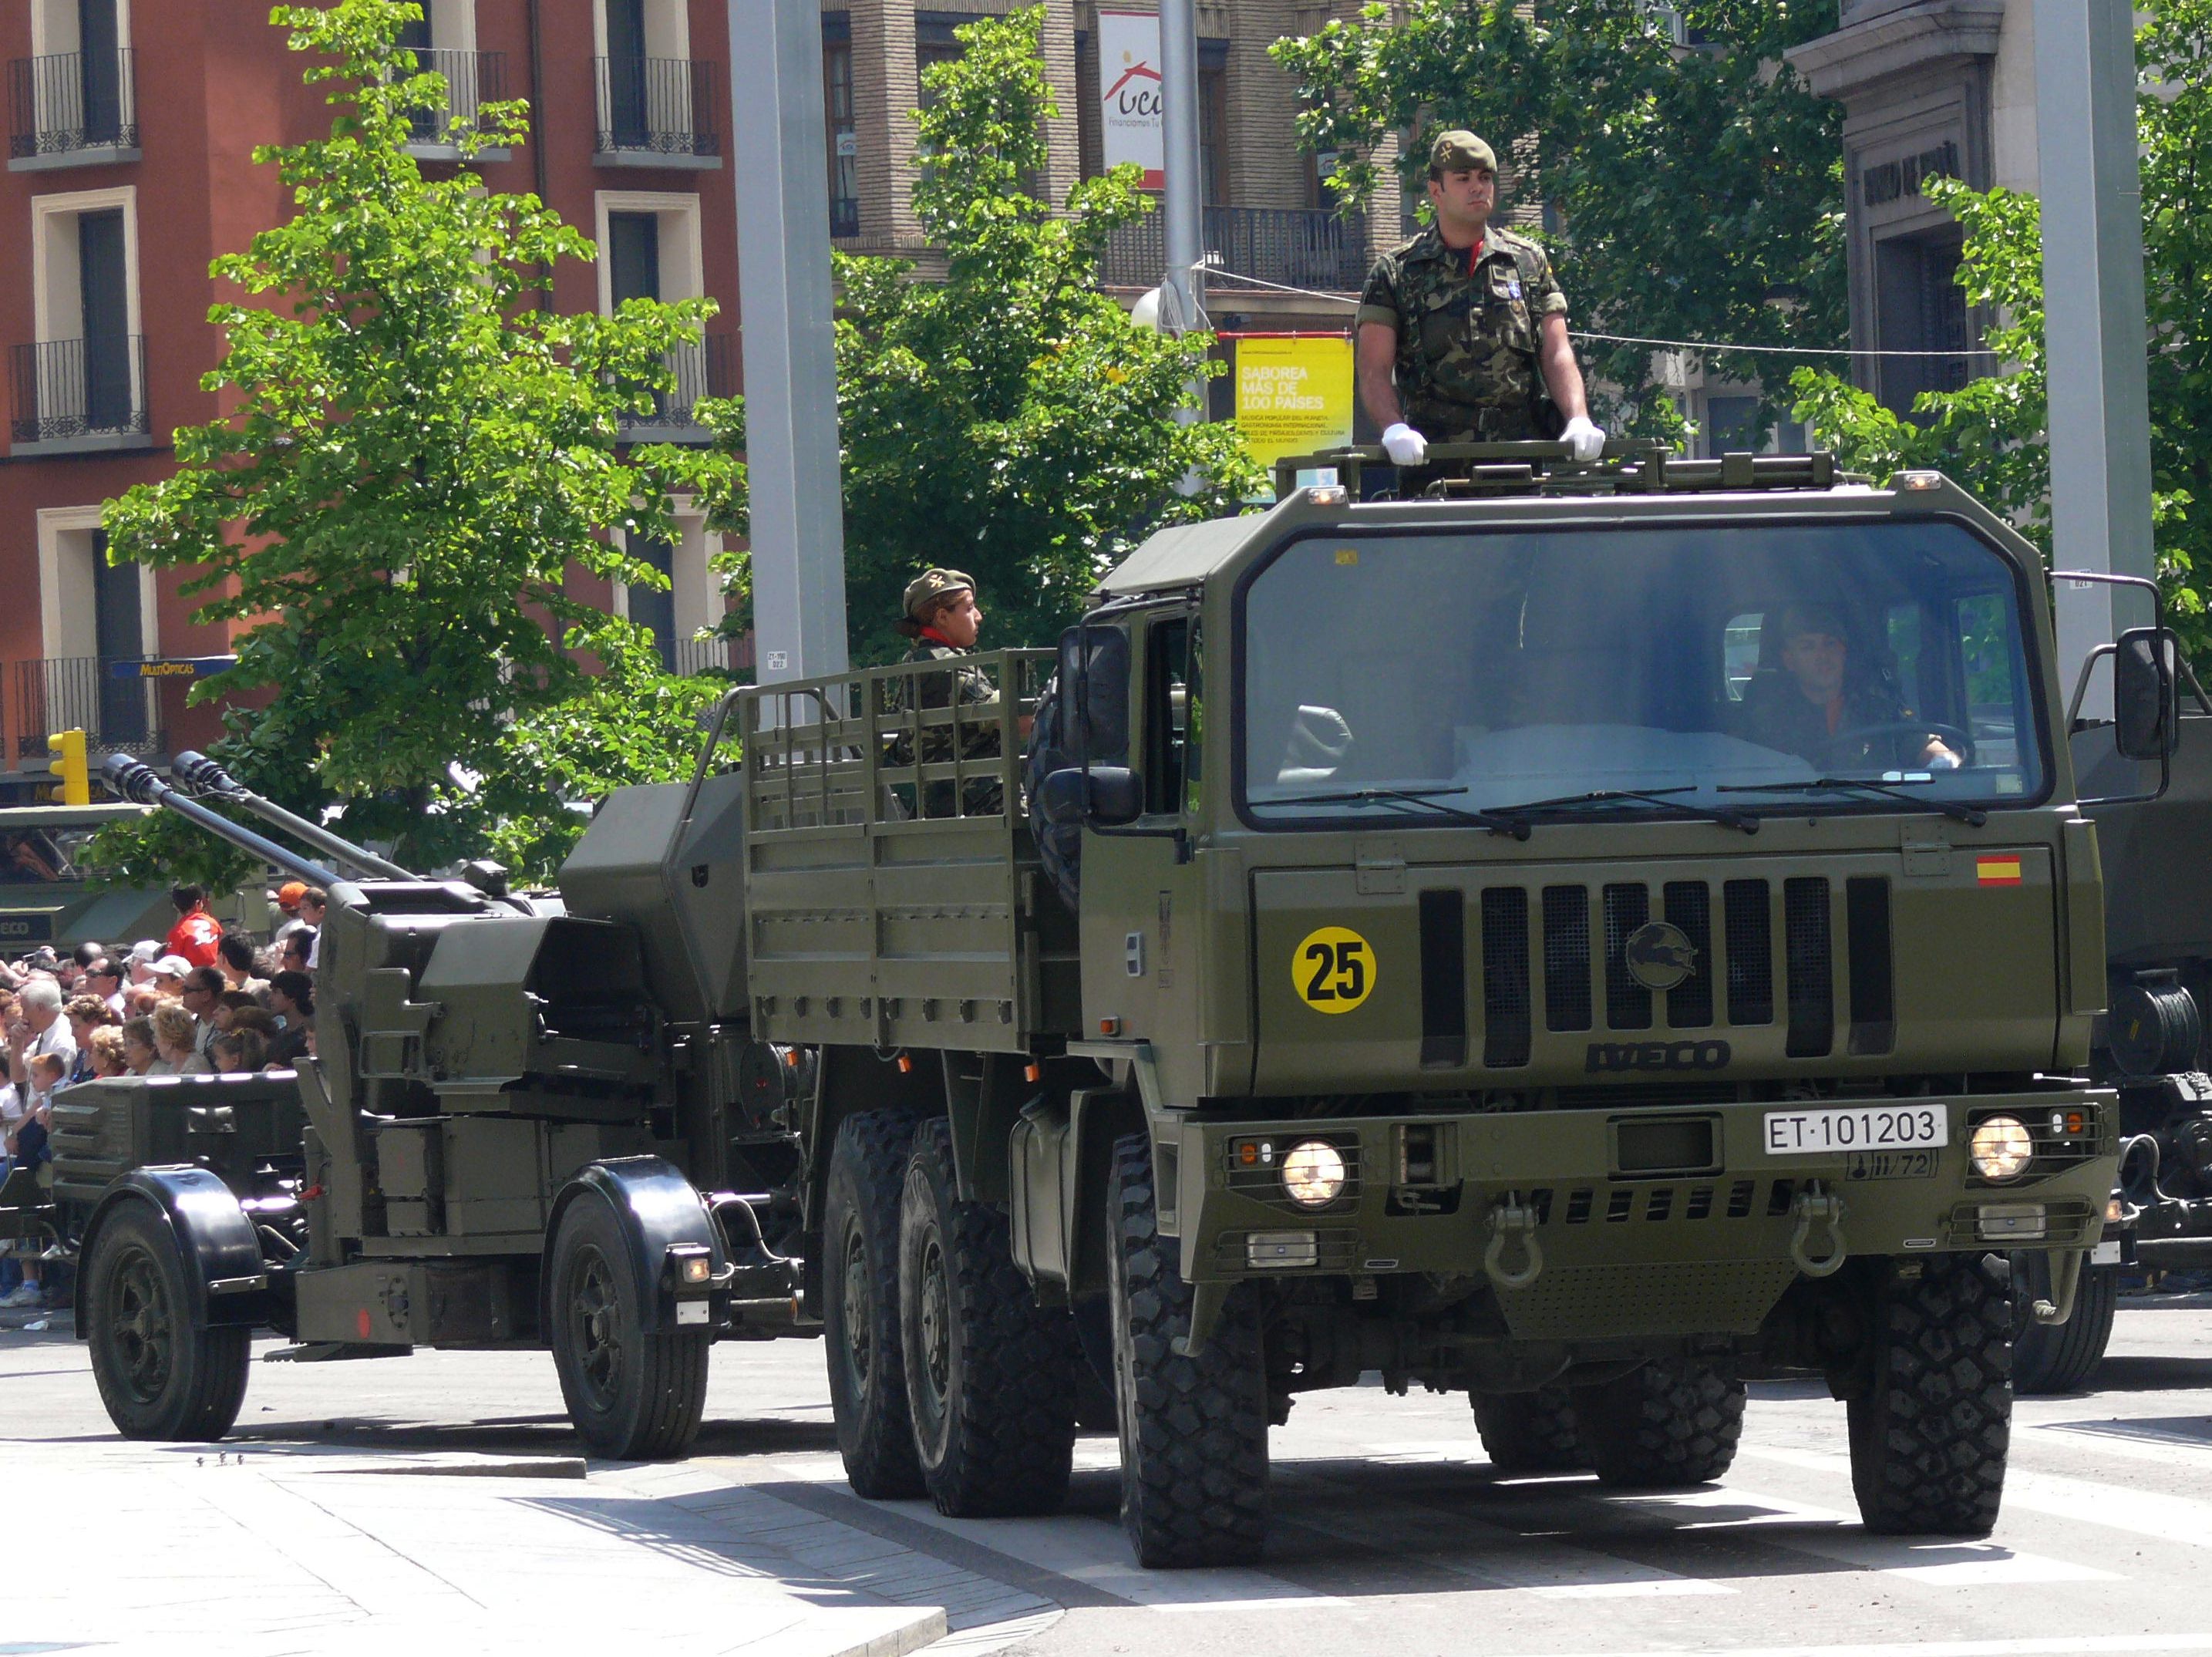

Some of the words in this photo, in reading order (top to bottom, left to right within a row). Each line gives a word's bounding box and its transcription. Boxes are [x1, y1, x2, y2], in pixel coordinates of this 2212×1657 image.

[1241, 366, 1308, 380] SABOREA
[1241, 380, 1274, 395] MÁS
[1278, 382, 1298, 395] DE
[1242, 396, 1271, 409] 100
[1305, 941, 1364, 1001] 25
[1585, 1039, 1731, 1072] IVECO
